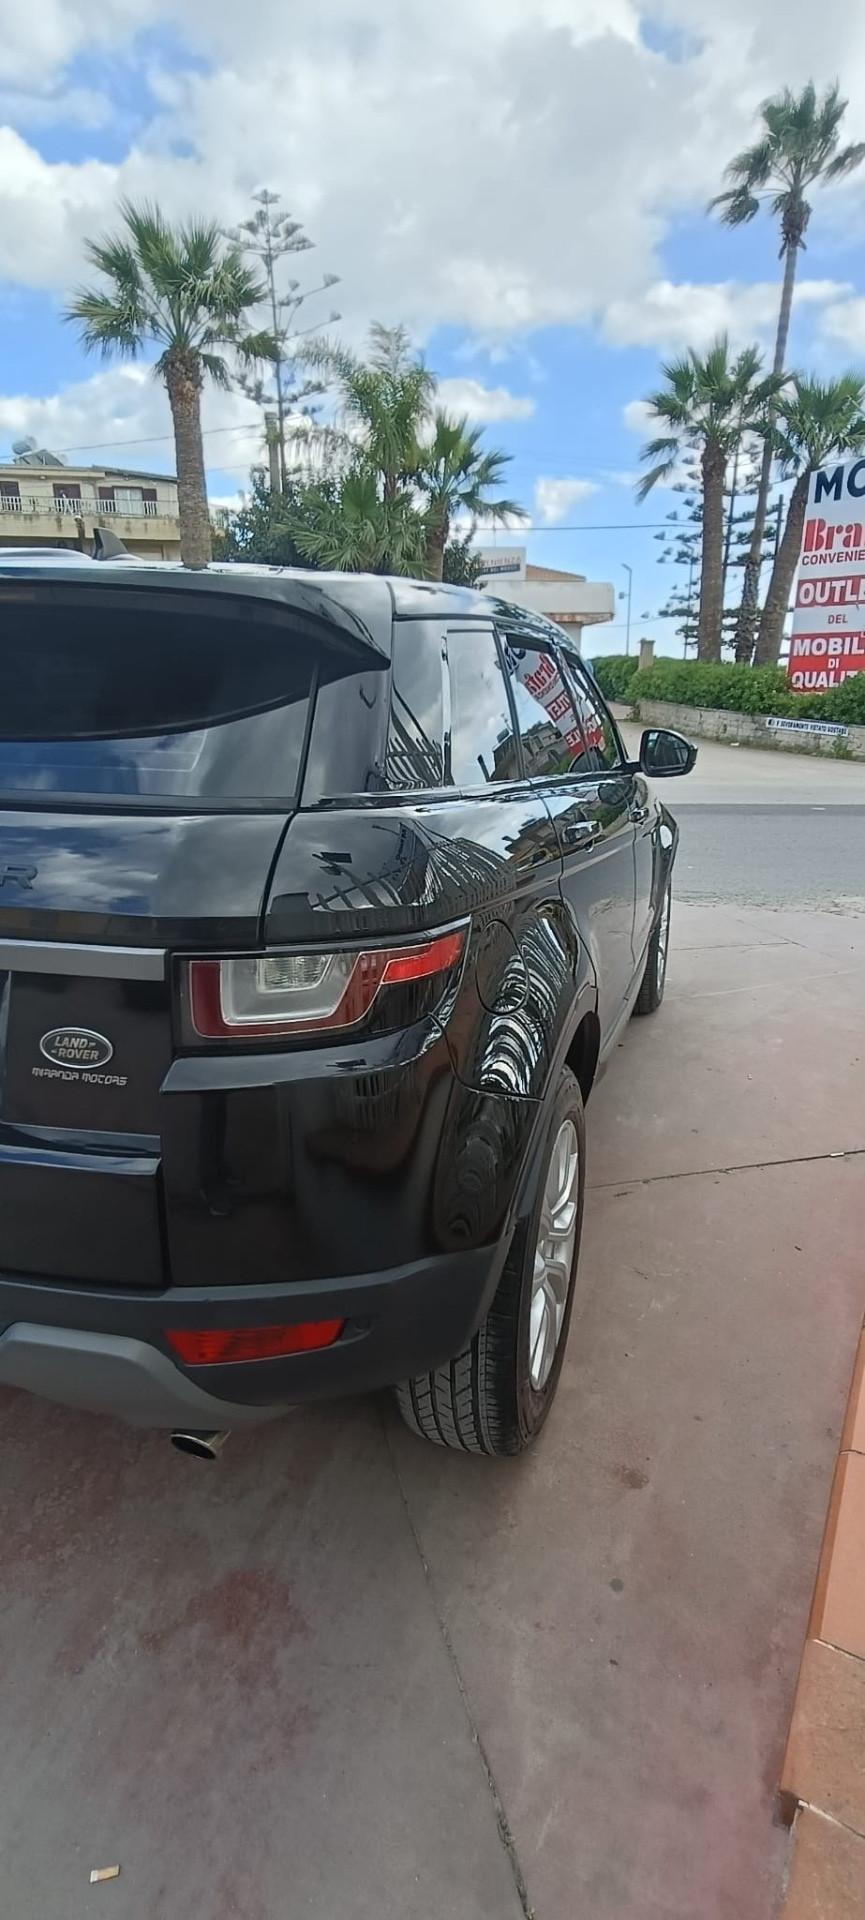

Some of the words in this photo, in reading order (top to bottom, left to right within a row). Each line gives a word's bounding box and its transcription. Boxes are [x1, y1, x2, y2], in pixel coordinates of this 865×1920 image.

[802, 549, 865, 566] CONVENIE
[828, 614, 848, 624] DEL
[828, 658, 839, 669] DI
[54, 1036, 88, 1049] LAND
[58, 1048, 99, 1060] ROVER
[32, 1067, 80, 1081] MIRANDA
[82, 1073, 128, 1087] MOTORS
